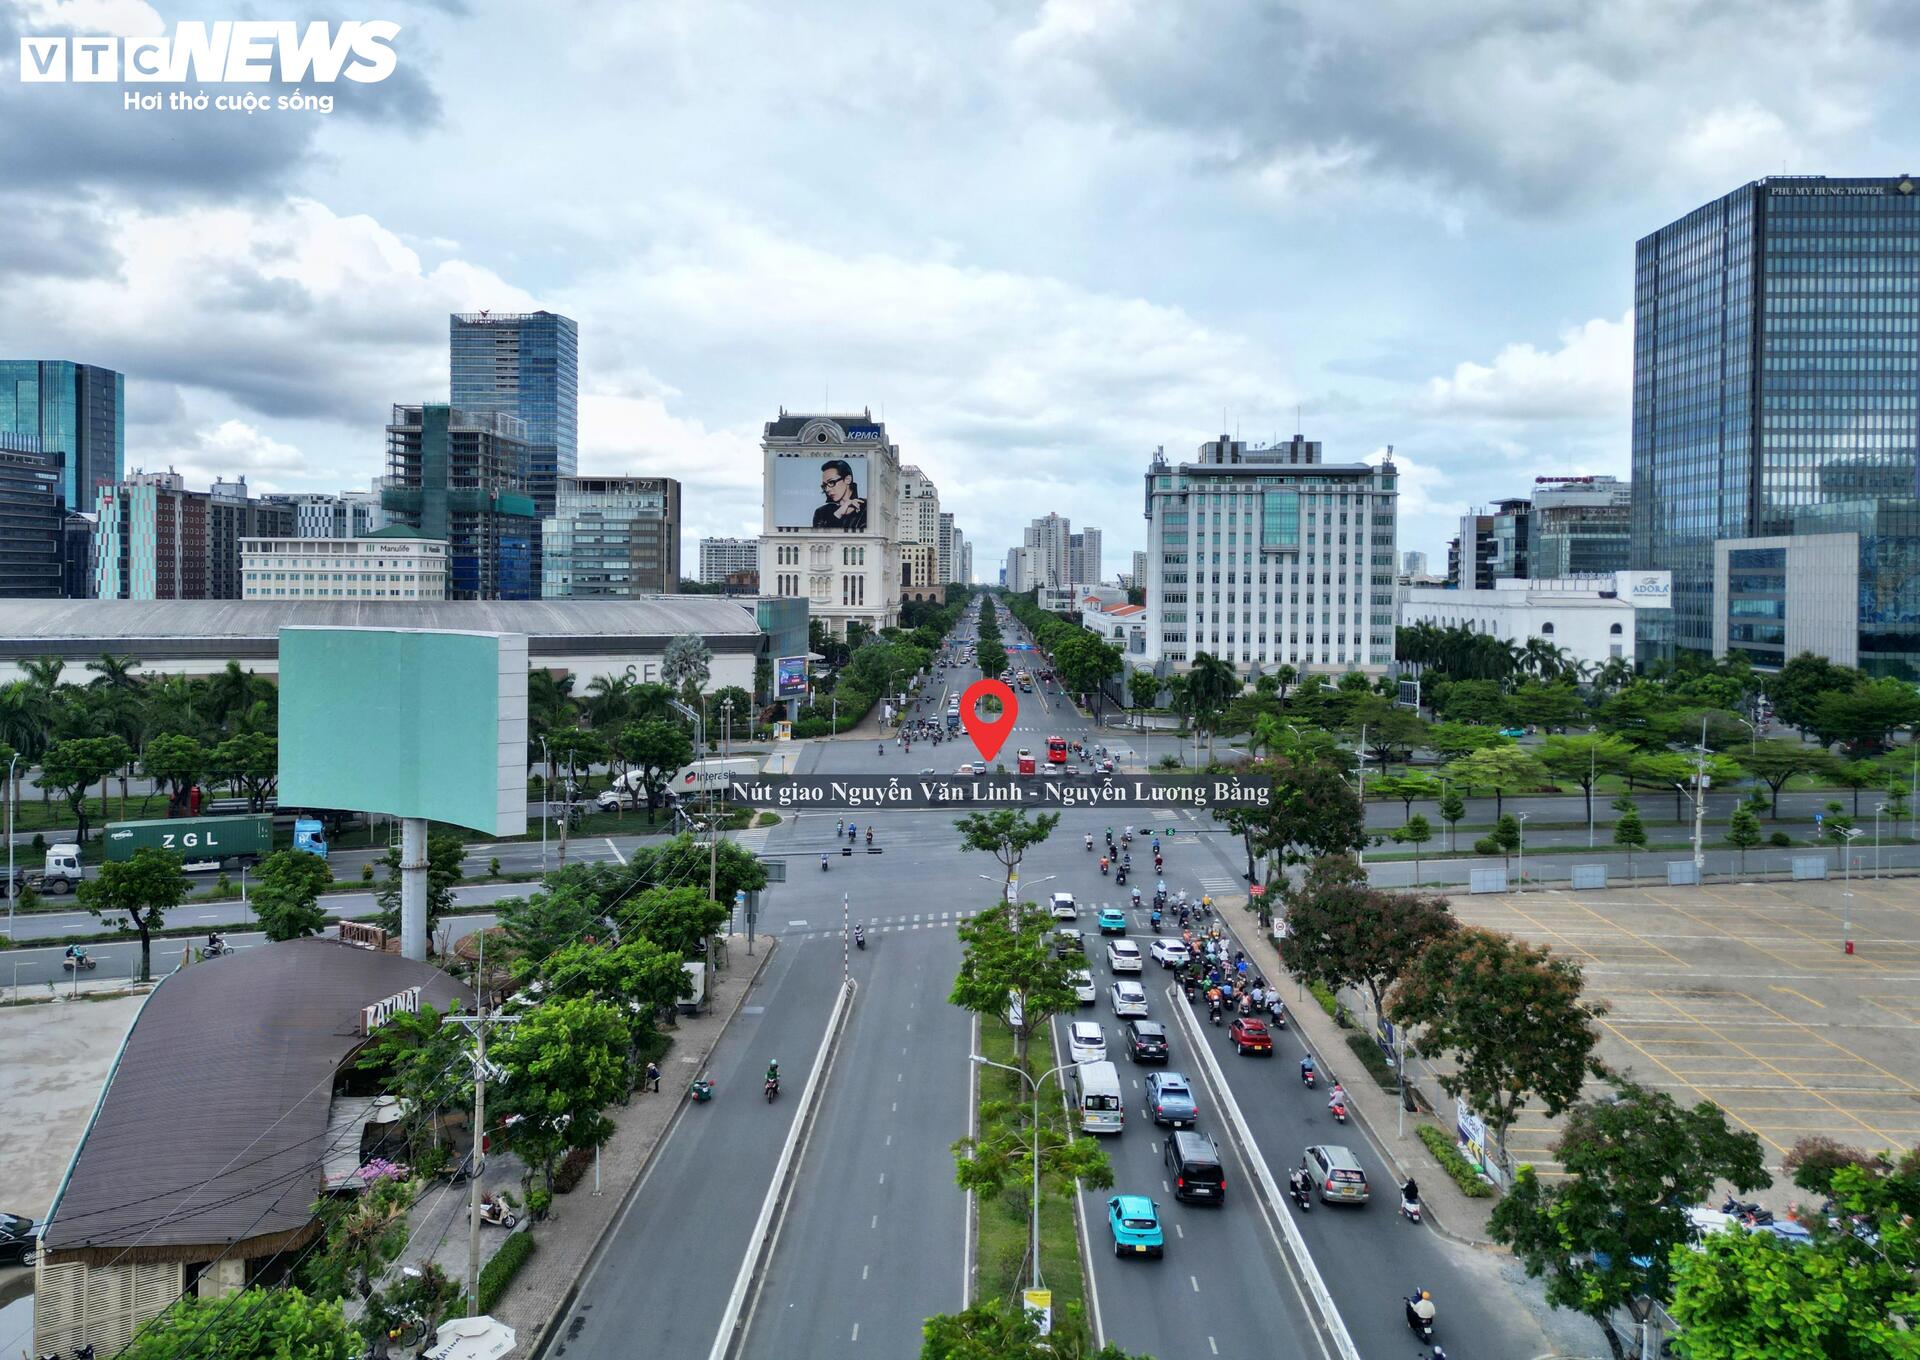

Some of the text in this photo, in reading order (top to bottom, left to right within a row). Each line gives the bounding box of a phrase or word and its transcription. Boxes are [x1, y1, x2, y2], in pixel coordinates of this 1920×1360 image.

[1771, 187, 1885, 195] PHU MY HUNG TOWER
[847, 431, 879, 440] KPMG
[380, 544, 410, 552] Manulife
[364, 987, 421, 1036] KATINAT
